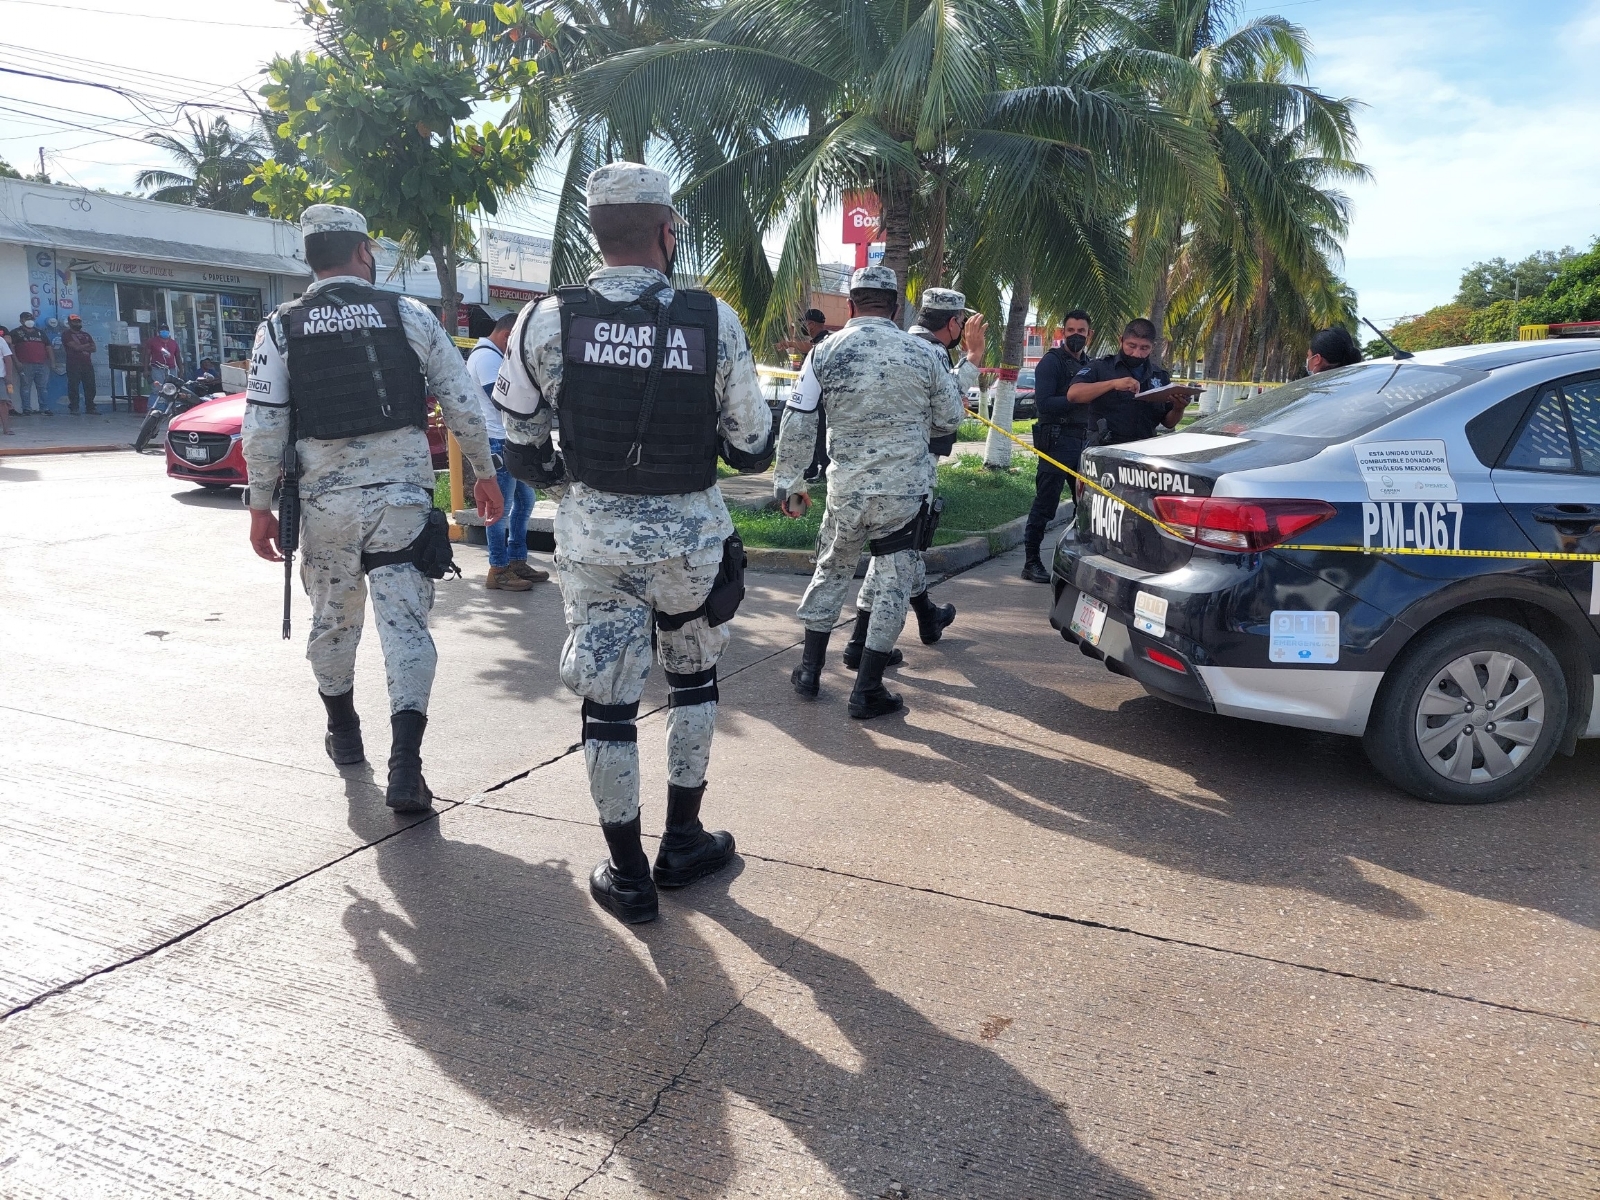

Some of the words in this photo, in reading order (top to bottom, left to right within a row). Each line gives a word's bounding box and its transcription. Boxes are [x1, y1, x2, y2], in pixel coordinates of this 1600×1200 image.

[208, 274, 240, 284] PAPELERIA
[308, 304, 380, 320] GUARDIA
[304, 315, 386, 335] NACIONAL
[1118, 466, 1194, 494] MUNICIPAL
[1092, 494, 1124, 542] PM-067
[1362, 502, 1464, 554] PM-067
